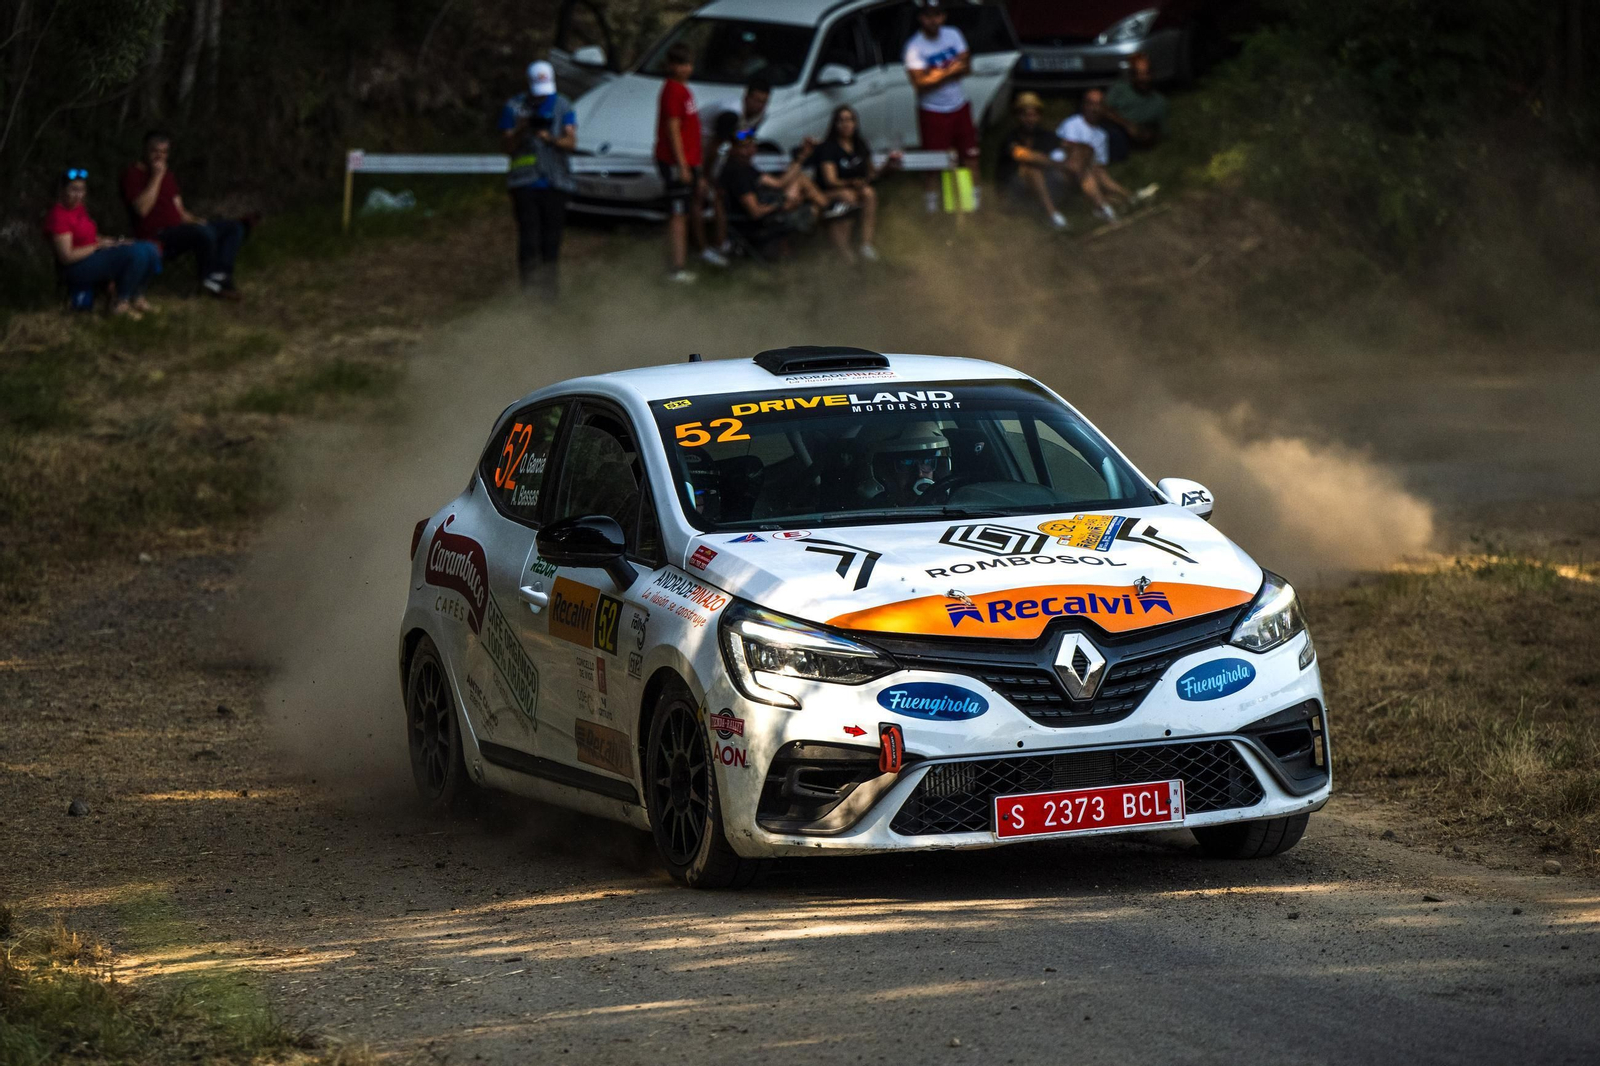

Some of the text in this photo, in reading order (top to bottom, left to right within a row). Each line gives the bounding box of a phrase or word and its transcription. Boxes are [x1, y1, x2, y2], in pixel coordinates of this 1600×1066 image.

[731, 390, 954, 417] DRIVELAND
[851, 401, 962, 413] MOTORSPORT
[675, 418, 751, 447] 52
[494, 422, 533, 490] 52
[430, 540, 485, 608] Carambuco
[924, 554, 1127, 579] ROMBOSOL
[653, 569, 727, 612] ANDRADEPINAZO
[435, 595, 465, 622] CAFÉS
[552, 592, 594, 632] Recalvi
[641, 587, 707, 628] La ilusión se construye
[986, 592, 1135, 623] Recalvi
[598, 599, 618, 651] 52
[1181, 664, 1250, 698] Fuengirola
[889, 689, 981, 715] Fuengirola
[713, 741, 747, 768] AON
[1011, 791, 1168, 829] S 2373 BCL
